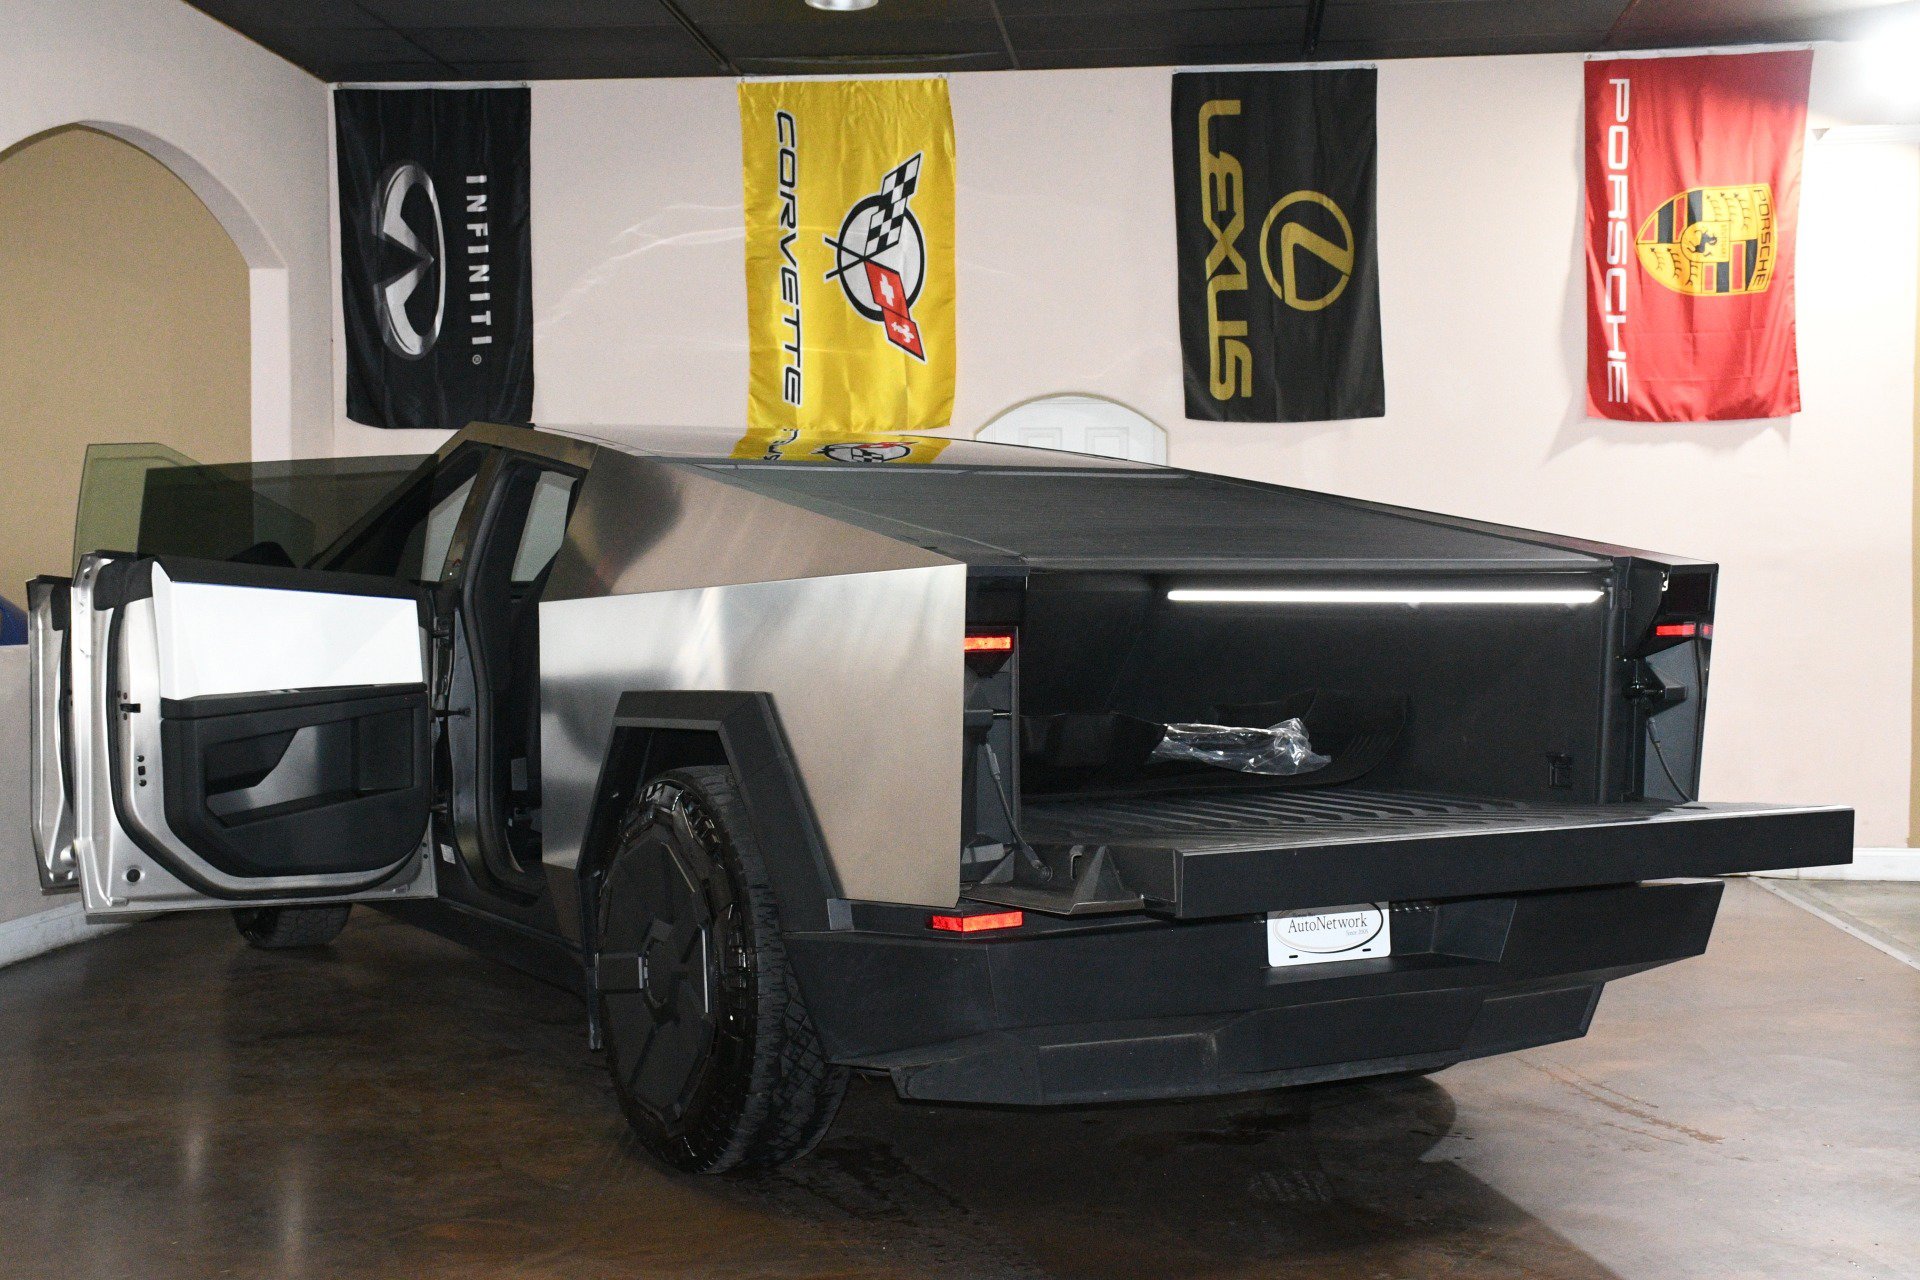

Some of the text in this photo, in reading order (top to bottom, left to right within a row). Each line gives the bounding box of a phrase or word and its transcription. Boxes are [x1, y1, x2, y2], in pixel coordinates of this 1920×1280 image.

[774, 109, 802, 408] CORVETTE
[1199, 100, 1252, 400] LEXUS
[1607, 78, 1631, 404] PORSCHE
[1753, 189, 1771, 286] PORSCHE
[1288, 913, 1368, 933] AutoNetwork
